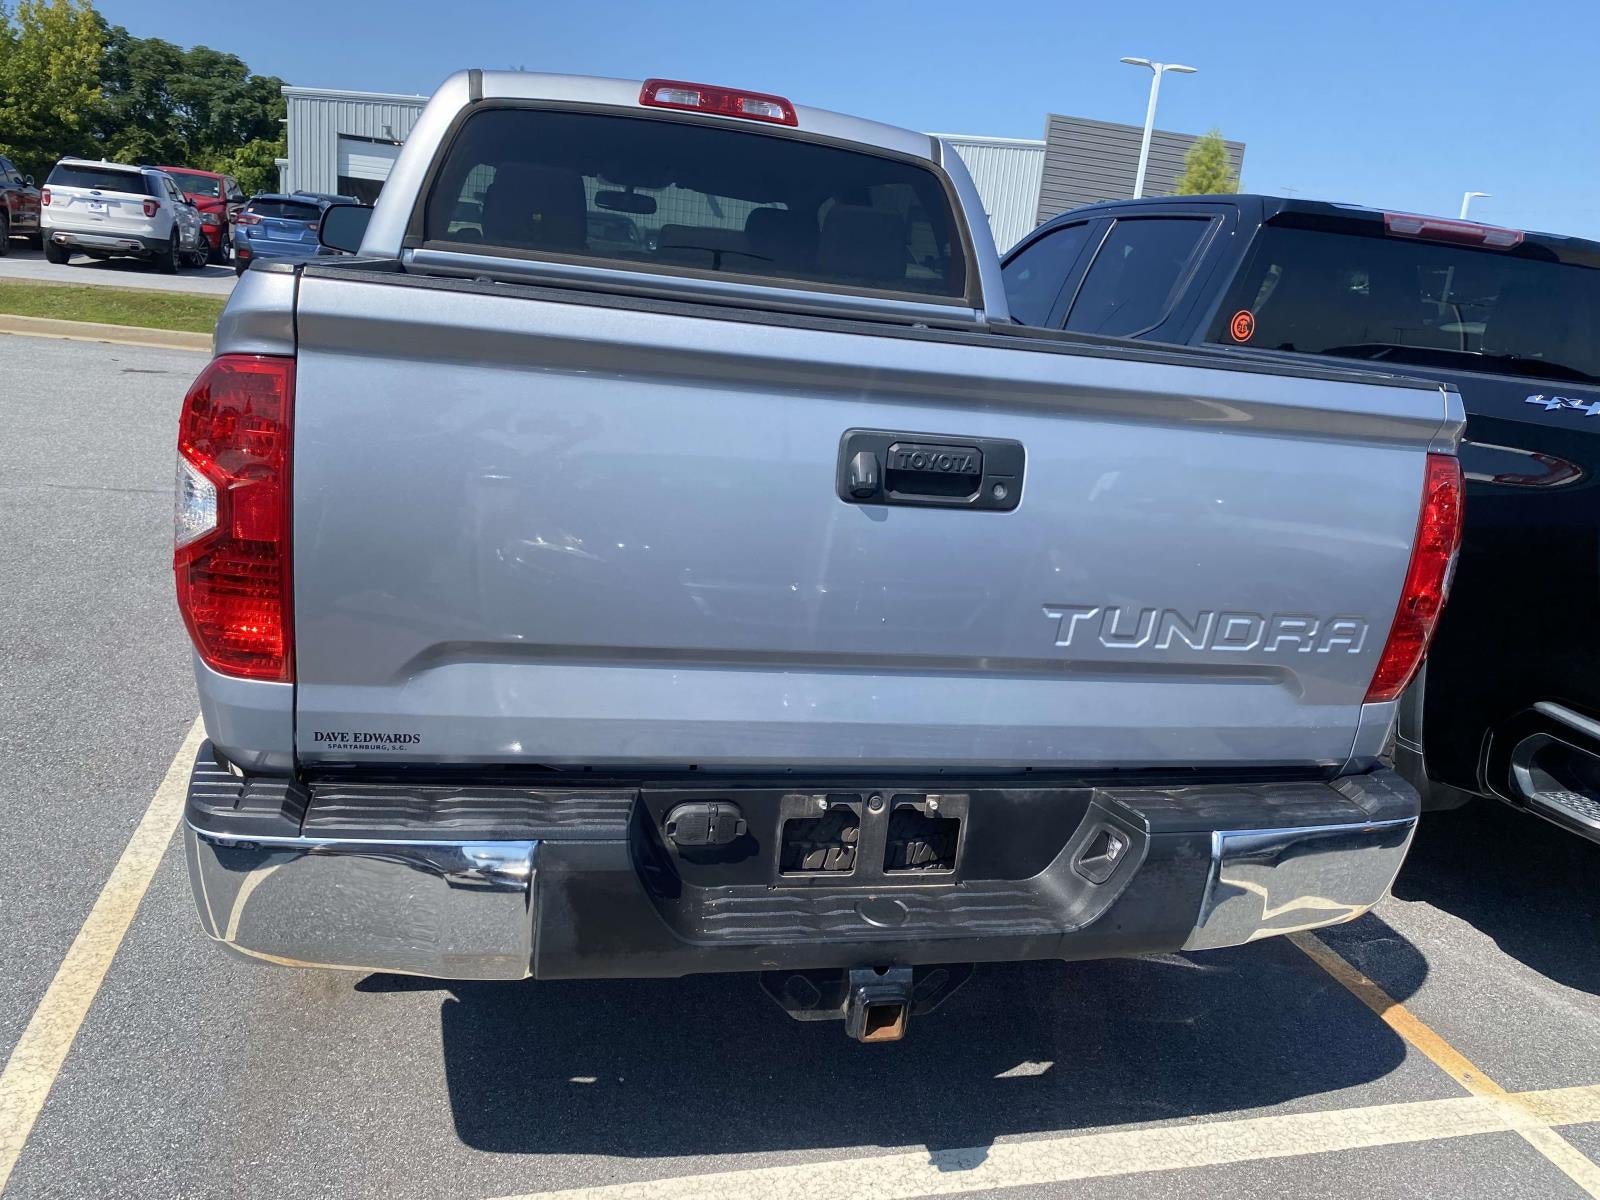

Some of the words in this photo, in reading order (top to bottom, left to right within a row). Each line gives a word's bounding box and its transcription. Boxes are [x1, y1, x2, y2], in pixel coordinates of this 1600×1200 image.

[898, 450, 976, 474] TOYOTA
[1043, 602, 1369, 654] TUNDRA
[313, 731, 349, 742] DAVE
[353, 732, 421, 744] EDWARDS
[327, 743, 390, 751] SPARTANBURG,
